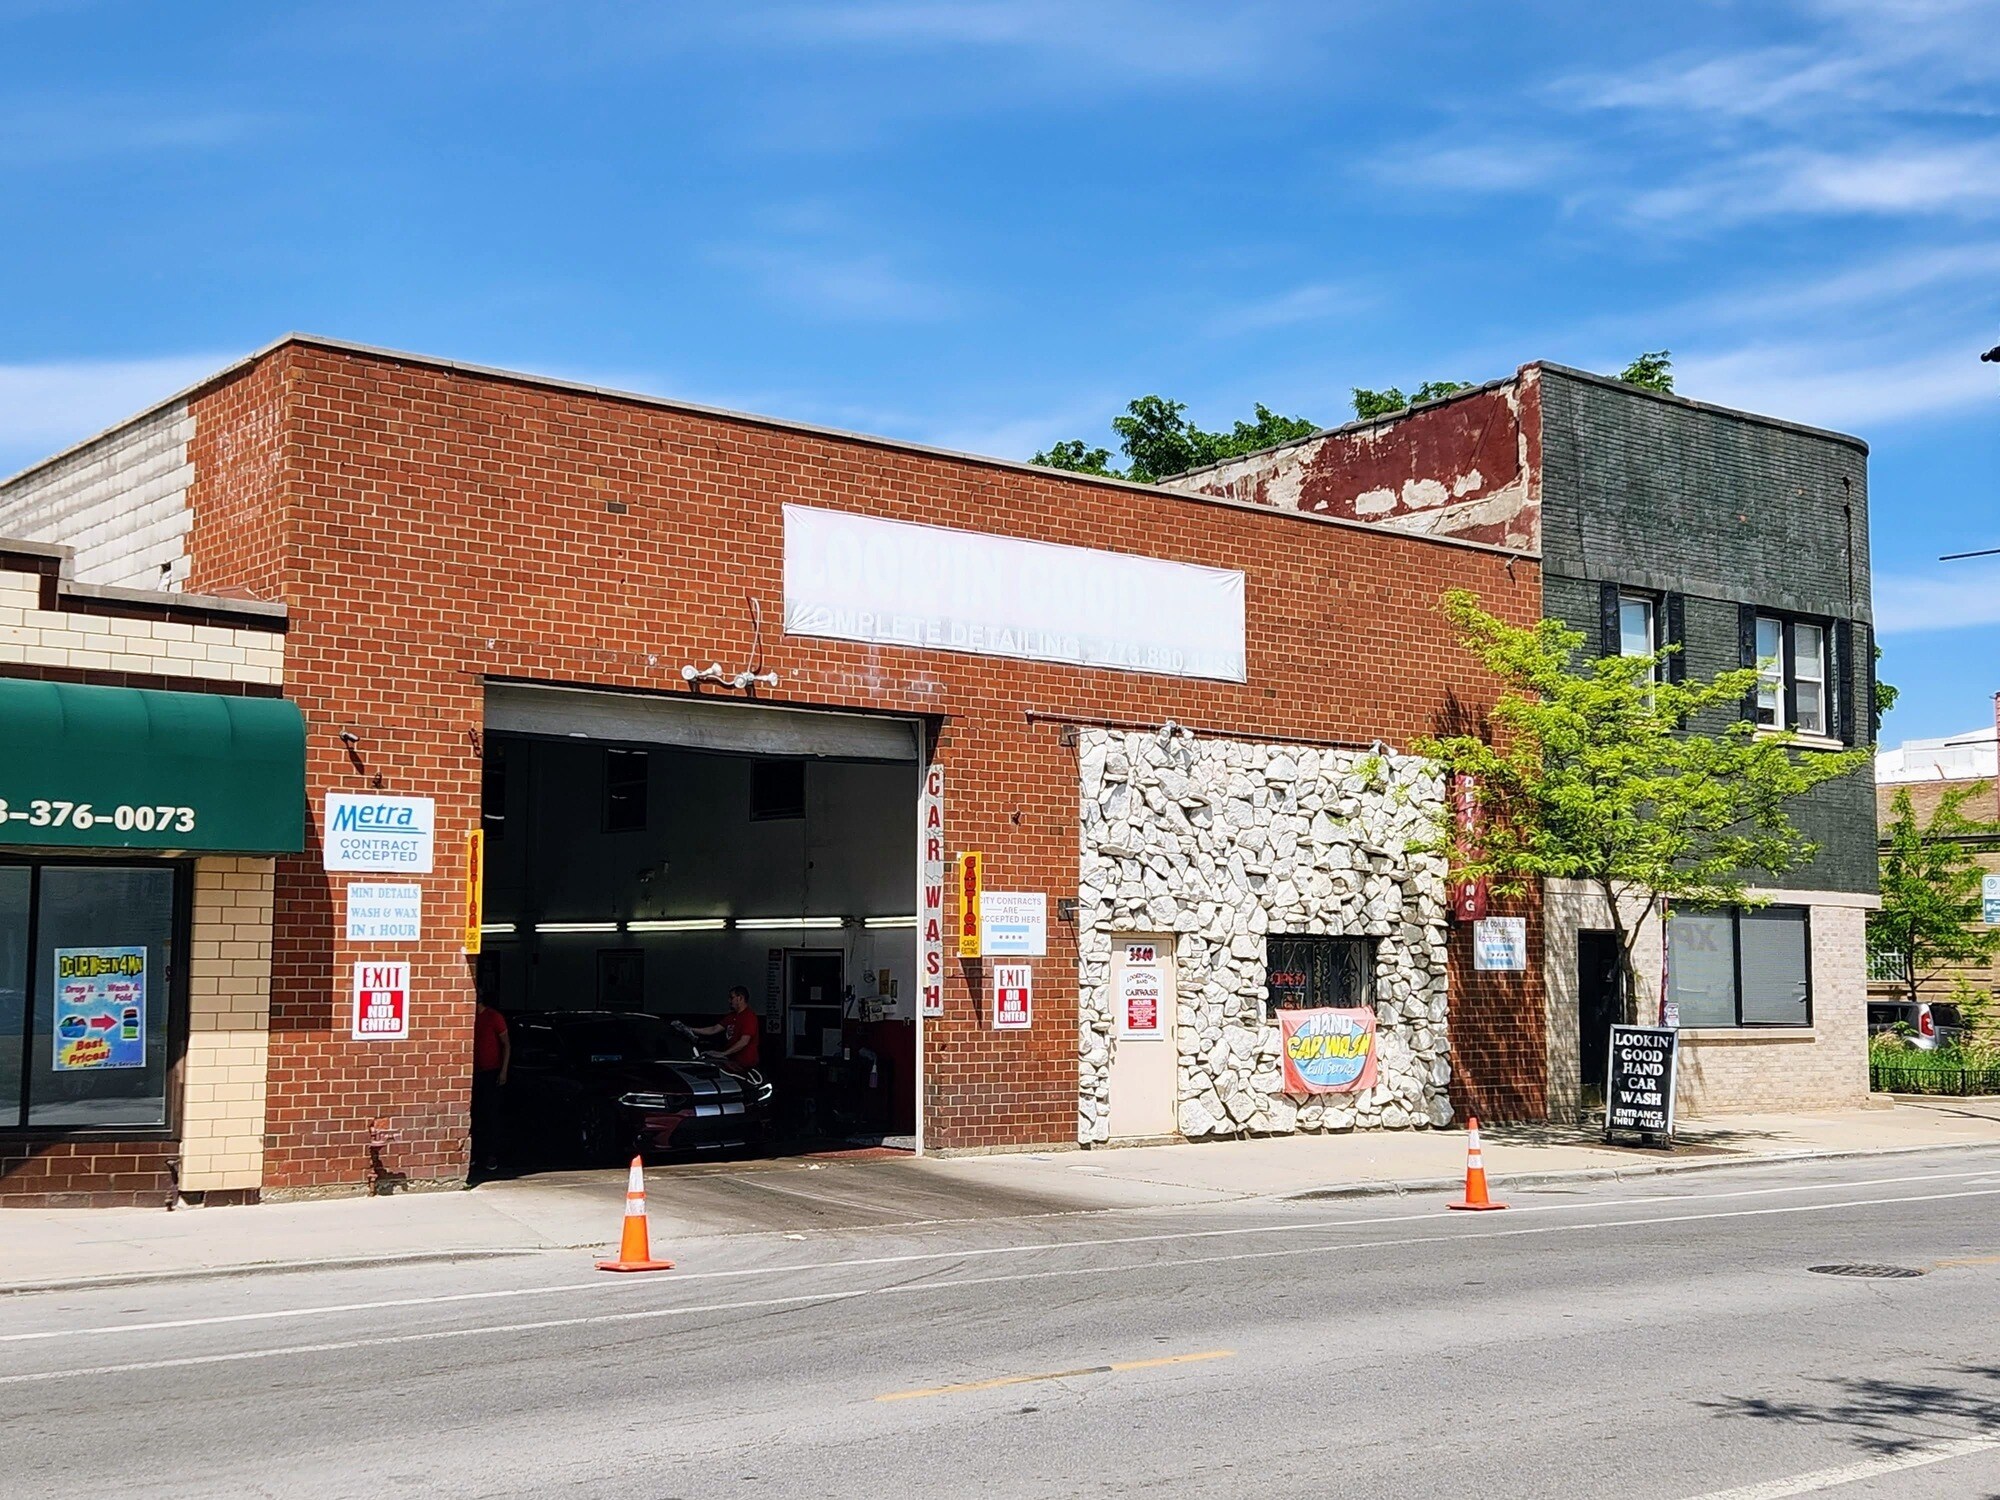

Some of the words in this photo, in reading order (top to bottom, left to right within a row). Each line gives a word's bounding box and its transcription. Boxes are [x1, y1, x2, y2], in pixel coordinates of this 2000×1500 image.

[951, 621, 1081, 657] DETAILING
[332, 803, 414, 832] Metra
[927, 771, 940, 862] CAR
[340, 839, 419, 851] CONTRACT
[341, 850, 418, 862] ACCEPTED
[469, 834, 478, 928] CAUTION
[351, 887, 373, 898] MINI
[378, 887, 418, 899] DETAILS
[964, 855, 977, 937] CAUTION
[997, 896, 1042, 906] CONTRACTS
[351, 907, 380, 918] WASH
[382, 907, 392, 918] &
[394, 907, 418, 918] WAX
[1003, 906, 1019, 914] ARE
[1021, 915, 1041, 924] HERE
[350, 924, 366, 937] IN
[369, 924, 376, 937] 1
[380, 924, 417, 937] HOUR
[924, 885, 942, 1009] WASH
[119, 955, 127, 975] 4
[363, 967, 402, 988] EXIT
[1000, 969, 1026, 987] EXIT
[65, 985, 86, 994] Drop
[87, 984, 95, 993] it
[107, 984, 130, 992] Wash
[1006, 989, 1020, 1001] DO
[73, 995, 86, 1003] off
[114, 994, 133, 1002] Fold
[371, 991, 391, 1005] DO
[367, 1004, 394, 1018] NOT
[1004, 1000, 1021, 1012] NOT
[1000, 1011, 1026, 1022] ENTER
[361, 1018, 401, 1032] ENTER
[1309, 1012, 1354, 1036] HAND
[76, 1038, 104, 1051] Best
[1287, 1034, 1323, 1060] CAR
[1323, 1032, 1373, 1060] WASH
[1614, 1033, 1673, 1048] LOOKIN'
[68, 1048, 111, 1065] Prices!
[1621, 1048, 1664, 1063] GOOD
[1328, 1062, 1356, 1076] Service
[1622, 1062, 1664, 1076] HAND
[1628, 1077, 1657, 1091] CAR
[1620, 1090, 1662, 1106] WASH
[1615, 1108, 1663, 1120] ENTRANCE
[1612, 1116, 1635, 1126] THRU
[1639, 1118, 1666, 1129] ALLEY
